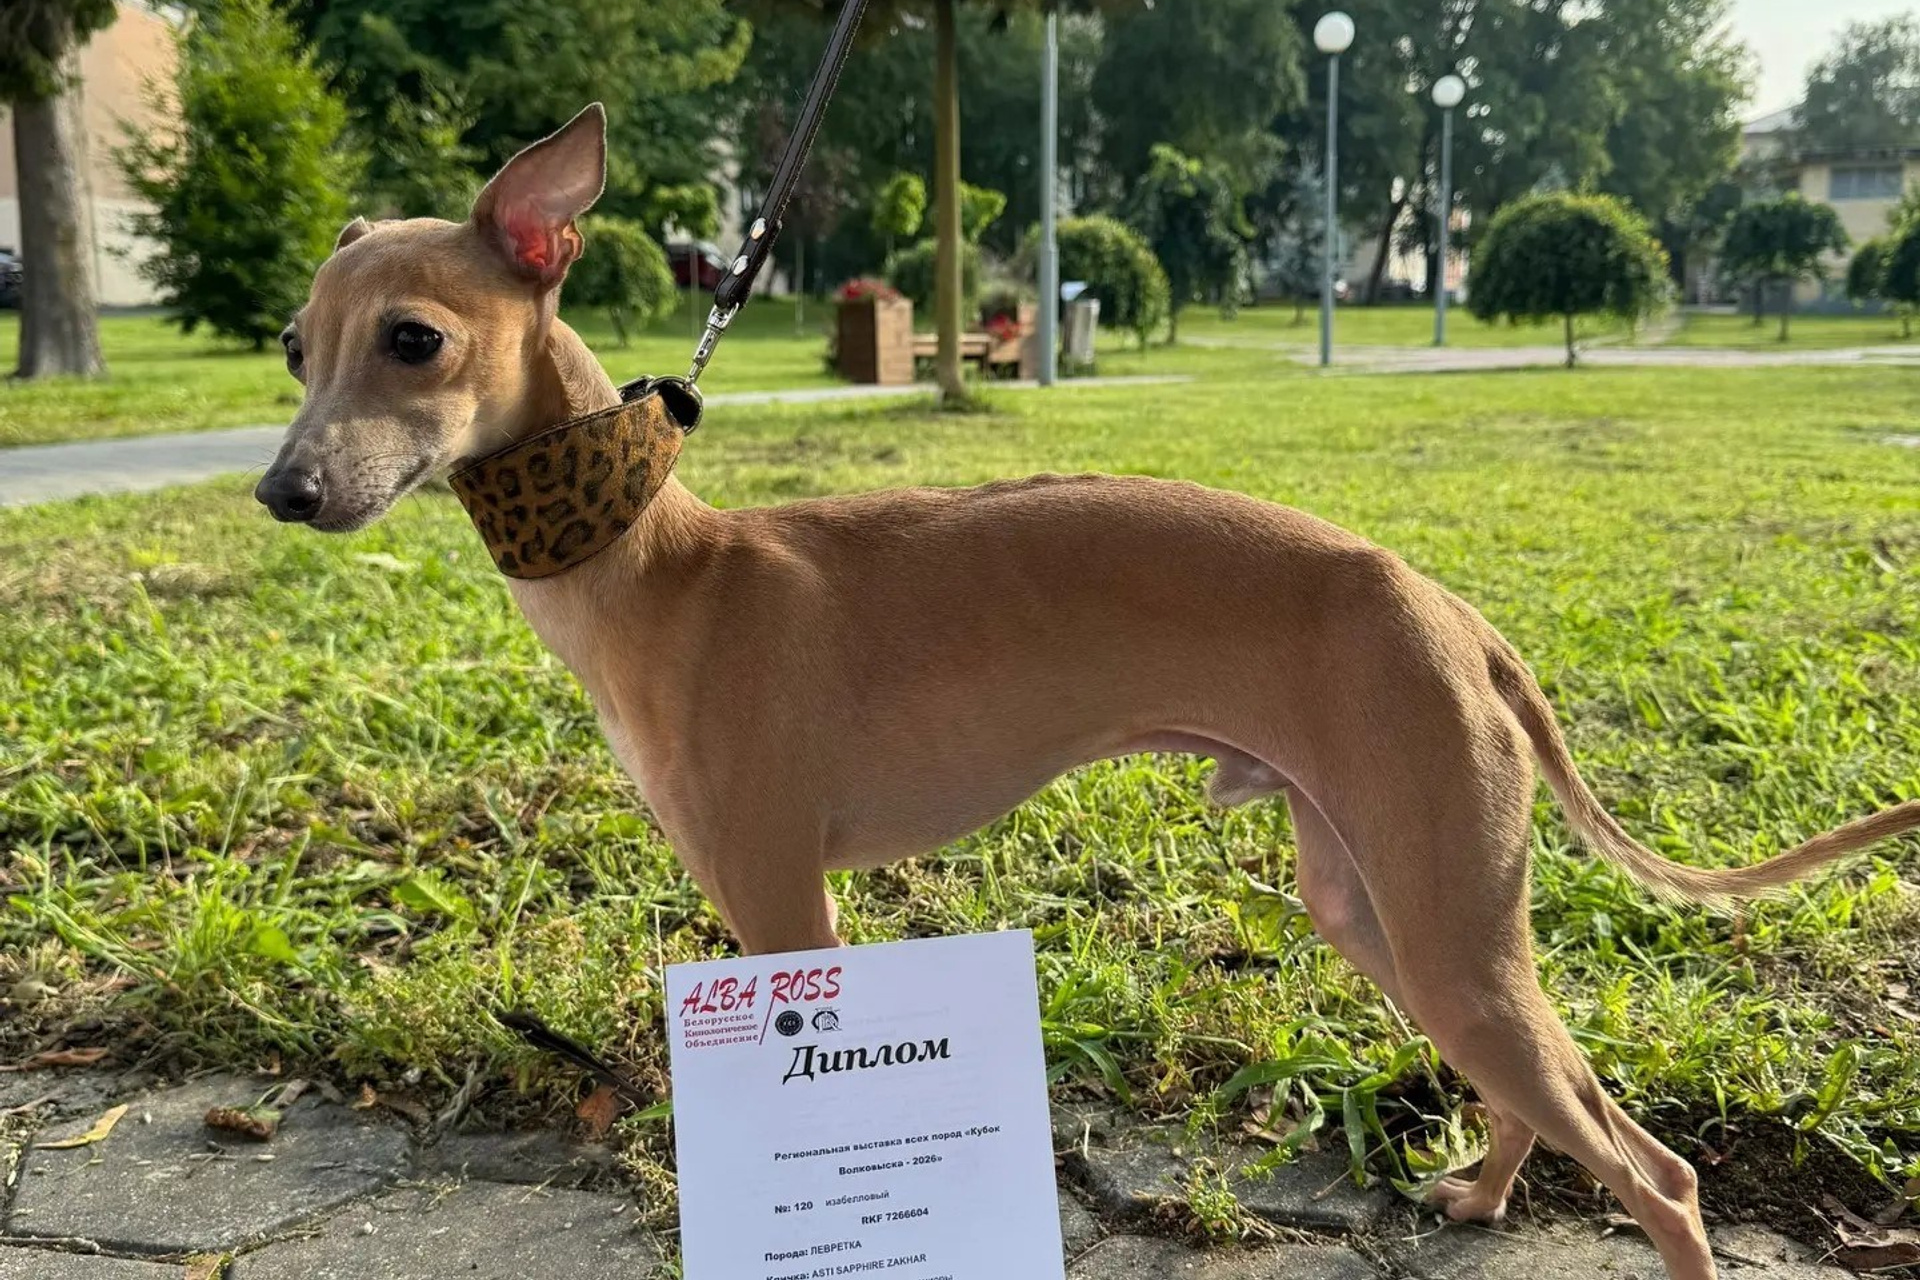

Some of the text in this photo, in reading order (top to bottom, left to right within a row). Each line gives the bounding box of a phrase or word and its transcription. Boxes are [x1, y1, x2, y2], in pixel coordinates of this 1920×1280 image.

[679, 966, 842, 1017] ALBA ROSS
[684, 1013, 754, 1027] Белорусское
[685, 1034, 759, 1048] Объединение
[782, 1037, 951, 1085] Диплом
[774, 1125, 1000, 1161] Региональная выставка всех пород «Кубок
[838, 1160, 904, 1176] Волковыска
[912, 1154, 943, 1166] 2026»
[794, 1201, 813, 1211] 120
[825, 1190, 890, 1207] изабелловый
[861, 1207, 929, 1225] RKF 7266604
[765, 1240, 862, 1261] Порода: ЛЕВРЕТКА
[812, 1267, 834, 1278] ASTI
[836, 1260, 885, 1275] SAPPHIRE
[886, 1253, 927, 1267] ZAKHAR
